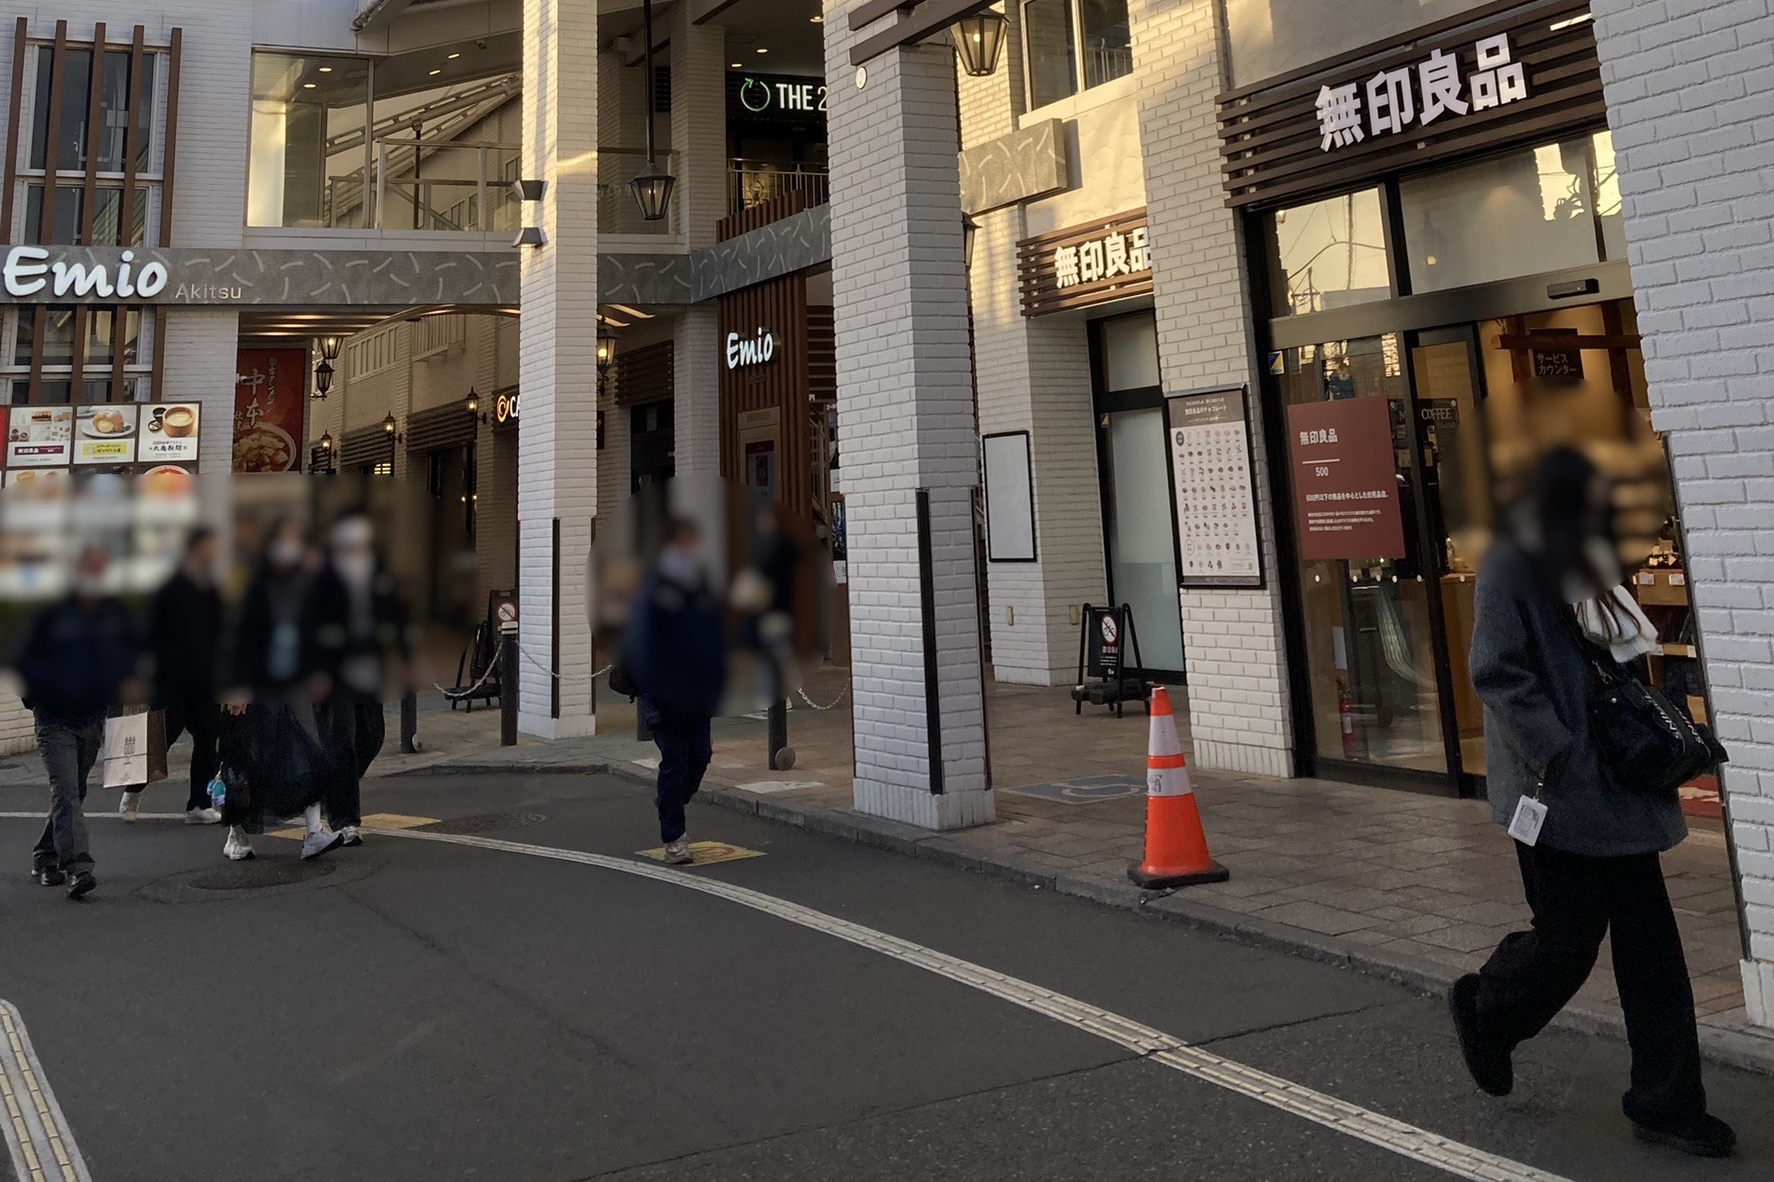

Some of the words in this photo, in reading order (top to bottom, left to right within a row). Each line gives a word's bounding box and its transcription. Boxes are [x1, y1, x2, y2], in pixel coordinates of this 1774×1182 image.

[775, 83, 814, 110] THE
[1314, 32, 1528, 153] 無印良品
[1054, 226, 1152, 289] 無印良品
[3, 245, 168, 298] Emio
[174, 283, 243, 300] Akitsu
[725, 326, 774, 369] Emio
[1536, 352, 1569, 364] サービス
[1538, 364, 1577, 376] カウンター
[1421, 408, 1452, 420] COFFEE
[1299, 428, 1338, 445] 無印良品
[1315, 466, 1329, 477] 500
